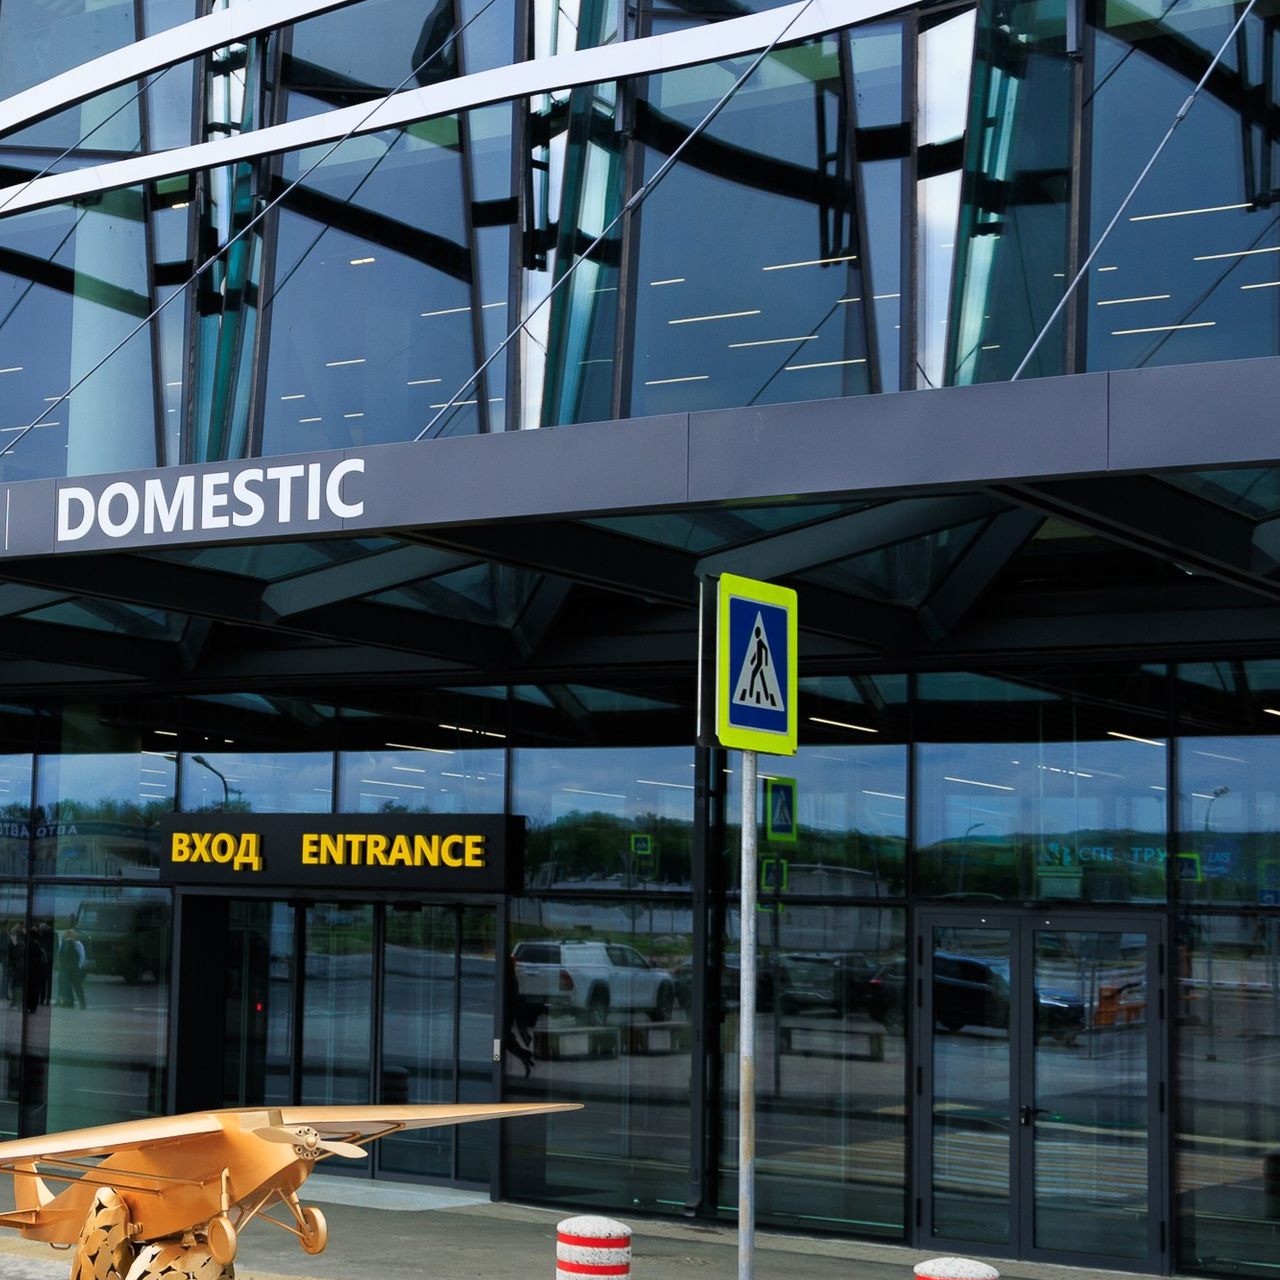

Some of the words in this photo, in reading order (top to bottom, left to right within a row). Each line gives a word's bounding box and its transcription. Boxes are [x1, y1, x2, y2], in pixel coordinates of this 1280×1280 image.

[57, 458, 364, 542] DOMESTIC
[171, 833, 262, 871] ВХОД
[302, 833, 485, 867] ENTRANCE
